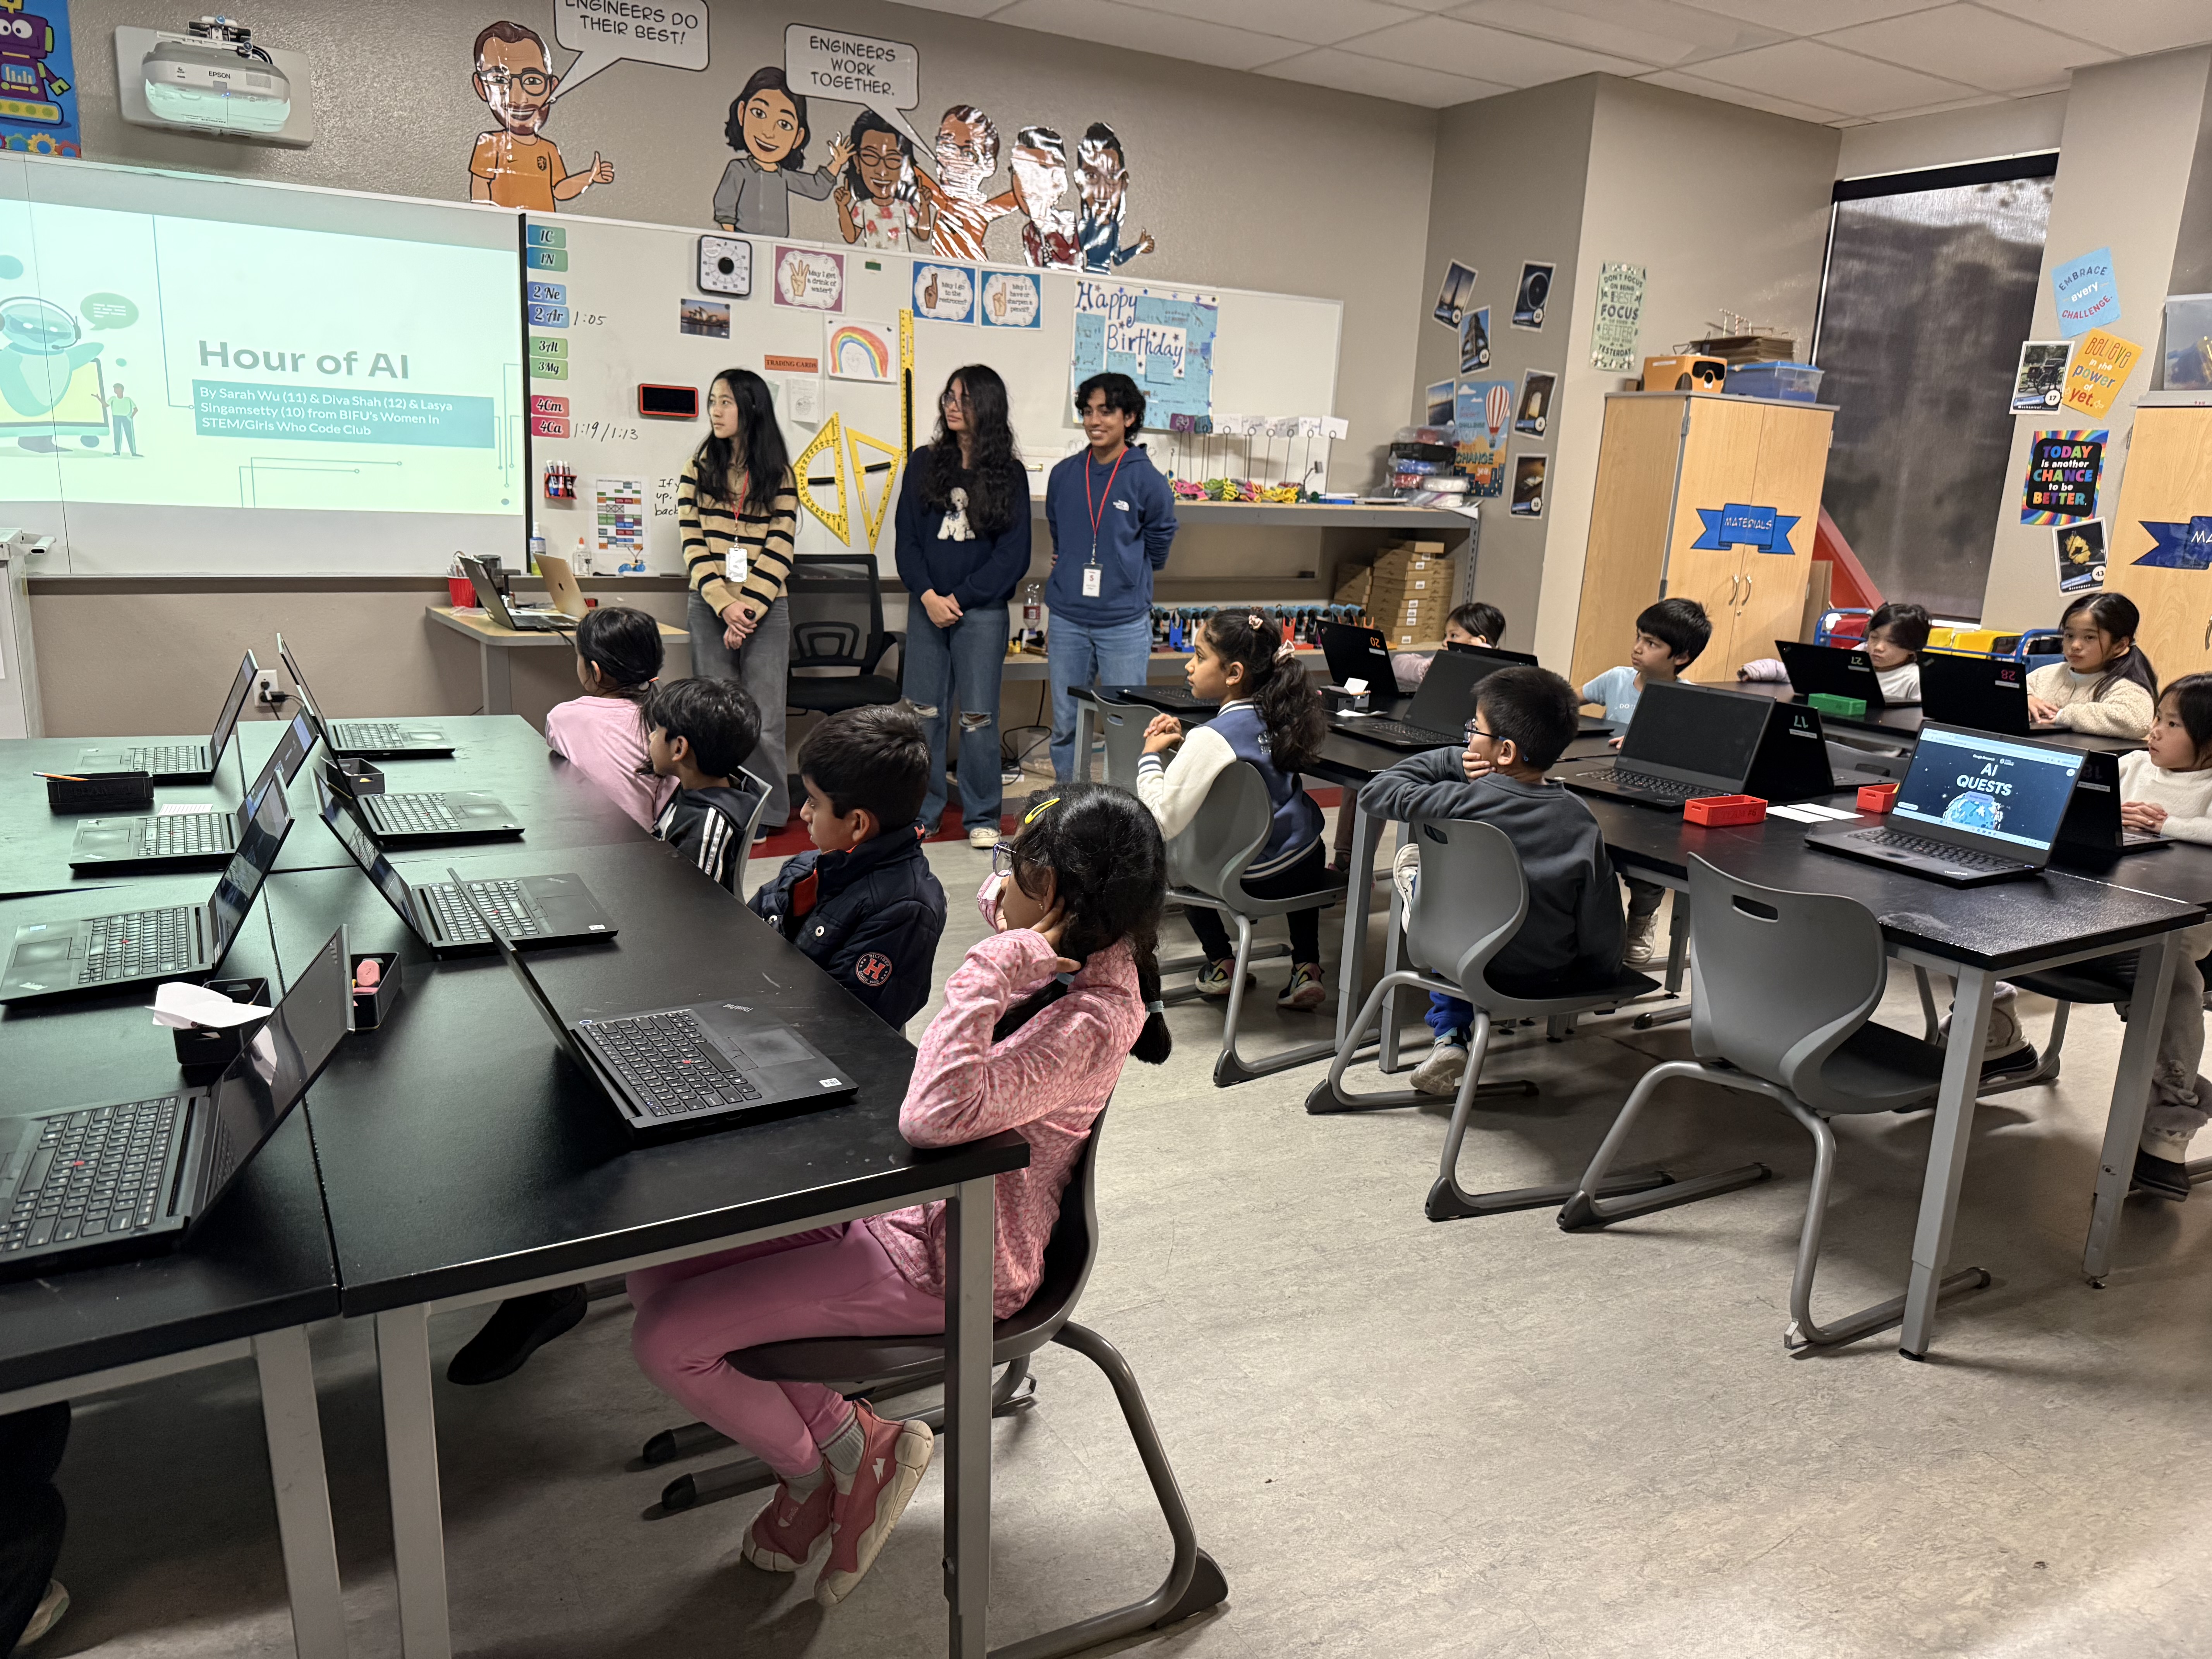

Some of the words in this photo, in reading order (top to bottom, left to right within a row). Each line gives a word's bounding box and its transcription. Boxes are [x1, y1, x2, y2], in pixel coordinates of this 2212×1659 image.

[672, 12, 698, 29] DO
[580, 15, 628, 35] THEIR
[635, 25, 685, 45] BEST!
[810, 36, 896, 62] ENGINEERS
[209, 71, 231, 79] EPSON
[831, 58, 875, 77] WORK
[811, 72, 895, 96] TOGETHER.
[1624, 275, 1644, 288] FOCUS
[2058, 265, 2108, 292] EMBRACE
[534, 286, 541, 298] 2
[544, 287, 560, 300] Ne
[2071, 280, 2099, 303] every
[1075, 282, 1138, 328] Happy
[1601, 304, 1639, 320] FOCUS
[2061, 295, 2113, 320] CHALLENGE.
[535, 307, 543, 320] 2
[546, 309, 563, 322] Ar
[574, 311, 607, 326] 1:05
[1602, 324, 1633, 339] BETTER
[1107, 324, 1184, 369] Birthday
[1598, 343, 1632, 357] YESTERDAY
[199, 340, 306, 373] Hour
[316, 350, 359, 376] of
[368, 352, 409, 380] AI
[2089, 358, 2097, 366] in
[2098, 358, 2113, 371] the
[2072, 364, 2116, 389] power
[2083, 383, 2094, 392] of
[199, 386, 217, 399] By
[219, 388, 255, 400] Sarah
[256, 390, 280, 402] Wu
[283, 391, 307, 404] (11)
[309, 394, 320, 404] &
[322, 395, 350, 406] Diva
[352, 396, 381, 407] Shah
[383, 397, 407, 410] (12)
[409, 399, 419, 409] &
[420, 400, 453, 412] Lasya
[2069, 386, 2094, 408] yet.
[200, 402, 278, 418] Singamsetty
[280, 407, 305, 419] (10)
[307, 408, 337, 419] from
[380, 412, 426, 424] Women
[276, 421, 307, 432] Who
[309, 424, 341, 434] Code
[343, 424, 372, 435] Club
[2043, 445, 2094, 459] TODAY
[2041, 459, 2049, 468] is
[2051, 460, 2089, 469] another
[658, 478, 674, 488] If
[2033, 469, 2094, 483] CHANCE
[2048, 483, 2058, 491] to
[2061, 483, 2073, 491] be
[656, 492, 672, 504] up.
[2033, 491, 2087, 506] BETTER.
[1724, 517, 1772, 530] MATERIALS
[1370, 636, 1381, 648] 20
[1851, 656, 1863, 665] 27
[2001, 669, 2016, 681] 28
[1793, 715, 1809, 728] 17
[1980, 763, 1999, 777] AI
[1956, 775, 2013, 796] QUESTS
